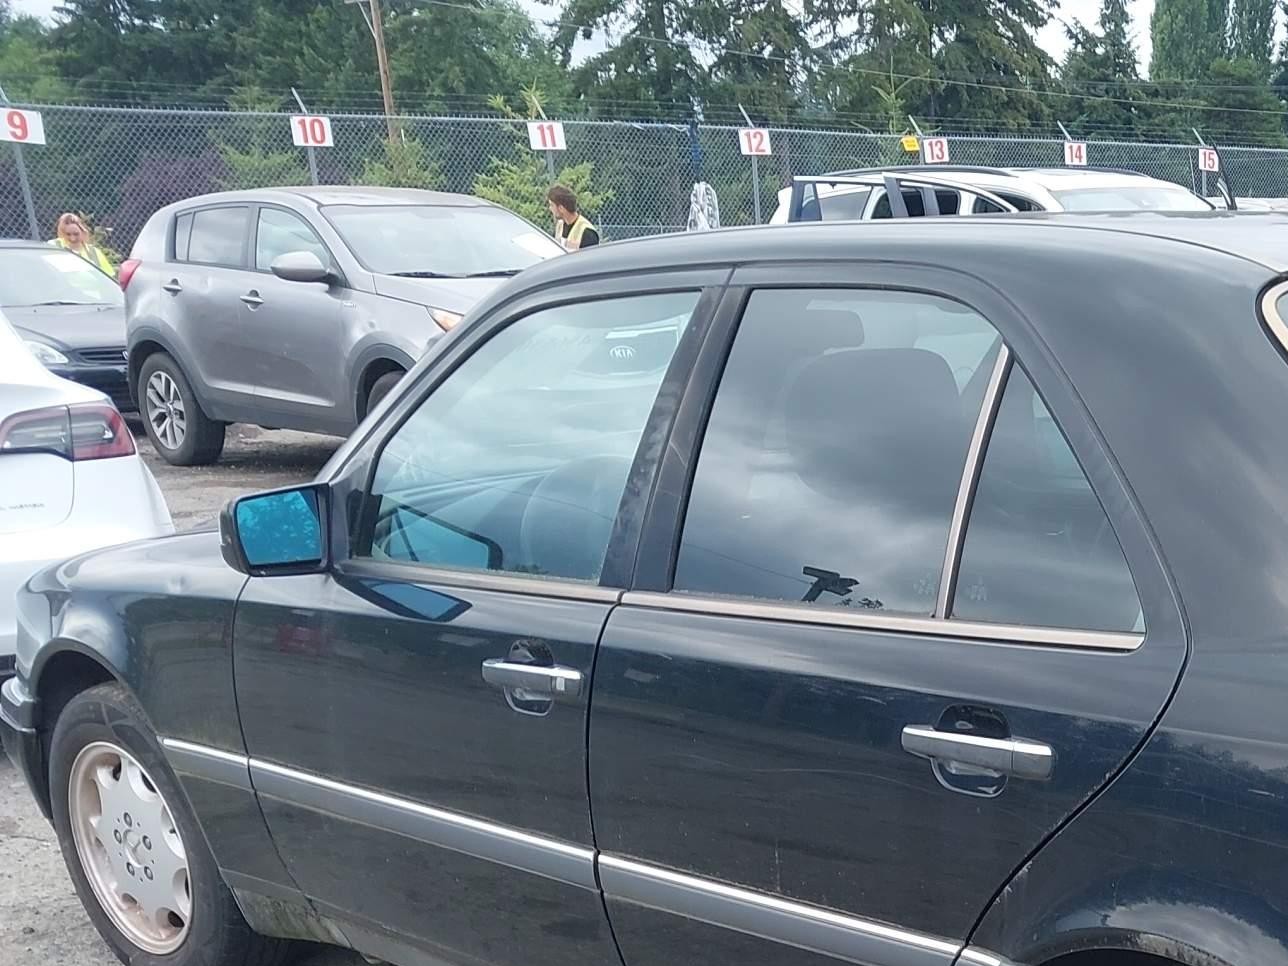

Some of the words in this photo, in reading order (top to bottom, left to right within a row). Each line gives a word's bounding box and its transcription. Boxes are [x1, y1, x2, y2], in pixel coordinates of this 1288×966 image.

[7, 110, 29, 141] 9
[298, 118, 326, 144] 10
[537, 124, 557, 148] 11
[745, 131, 767, 153] 12
[927, 140, 945, 161] 13
[1068, 143, 1084, 164] 14
[1202, 150, 1215, 170] 15
